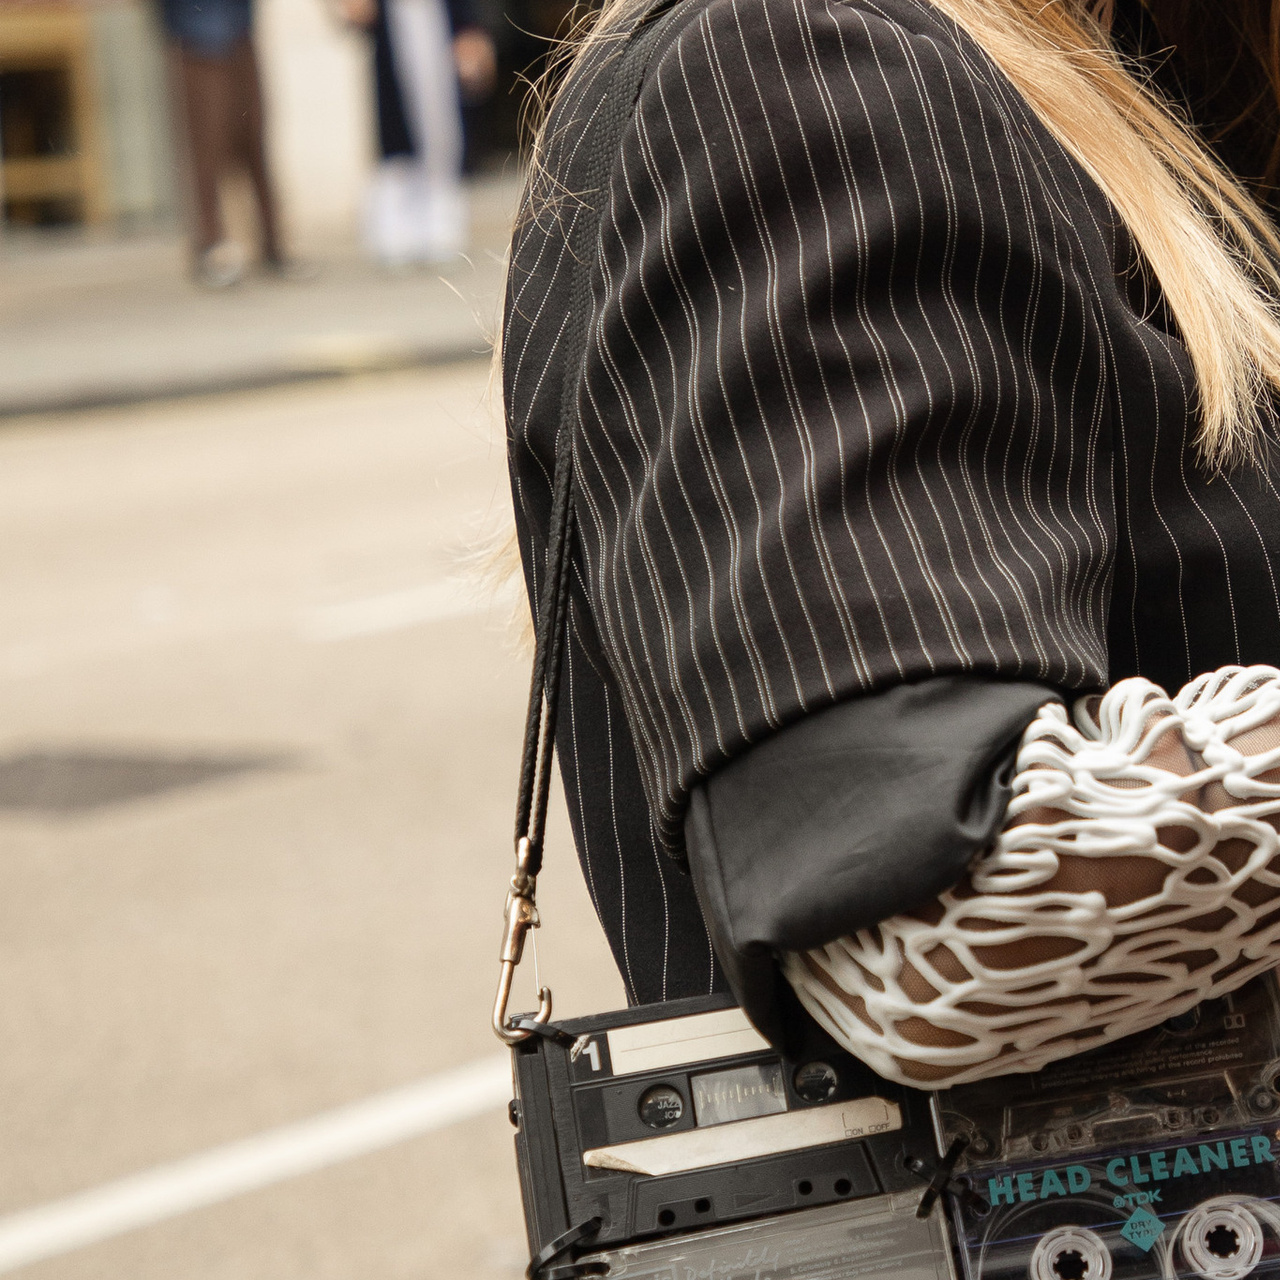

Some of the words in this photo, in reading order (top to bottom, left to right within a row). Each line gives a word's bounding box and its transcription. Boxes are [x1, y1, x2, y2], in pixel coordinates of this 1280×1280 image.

[582, 1041, 600, 1071] 1
[988, 1165, 1091, 1207] HEAD
[1105, 1135, 1276, 1187] CLEANER
[1123, 1188, 1163, 1206] TDK
[1130, 1218, 1152, 1230] DRY
